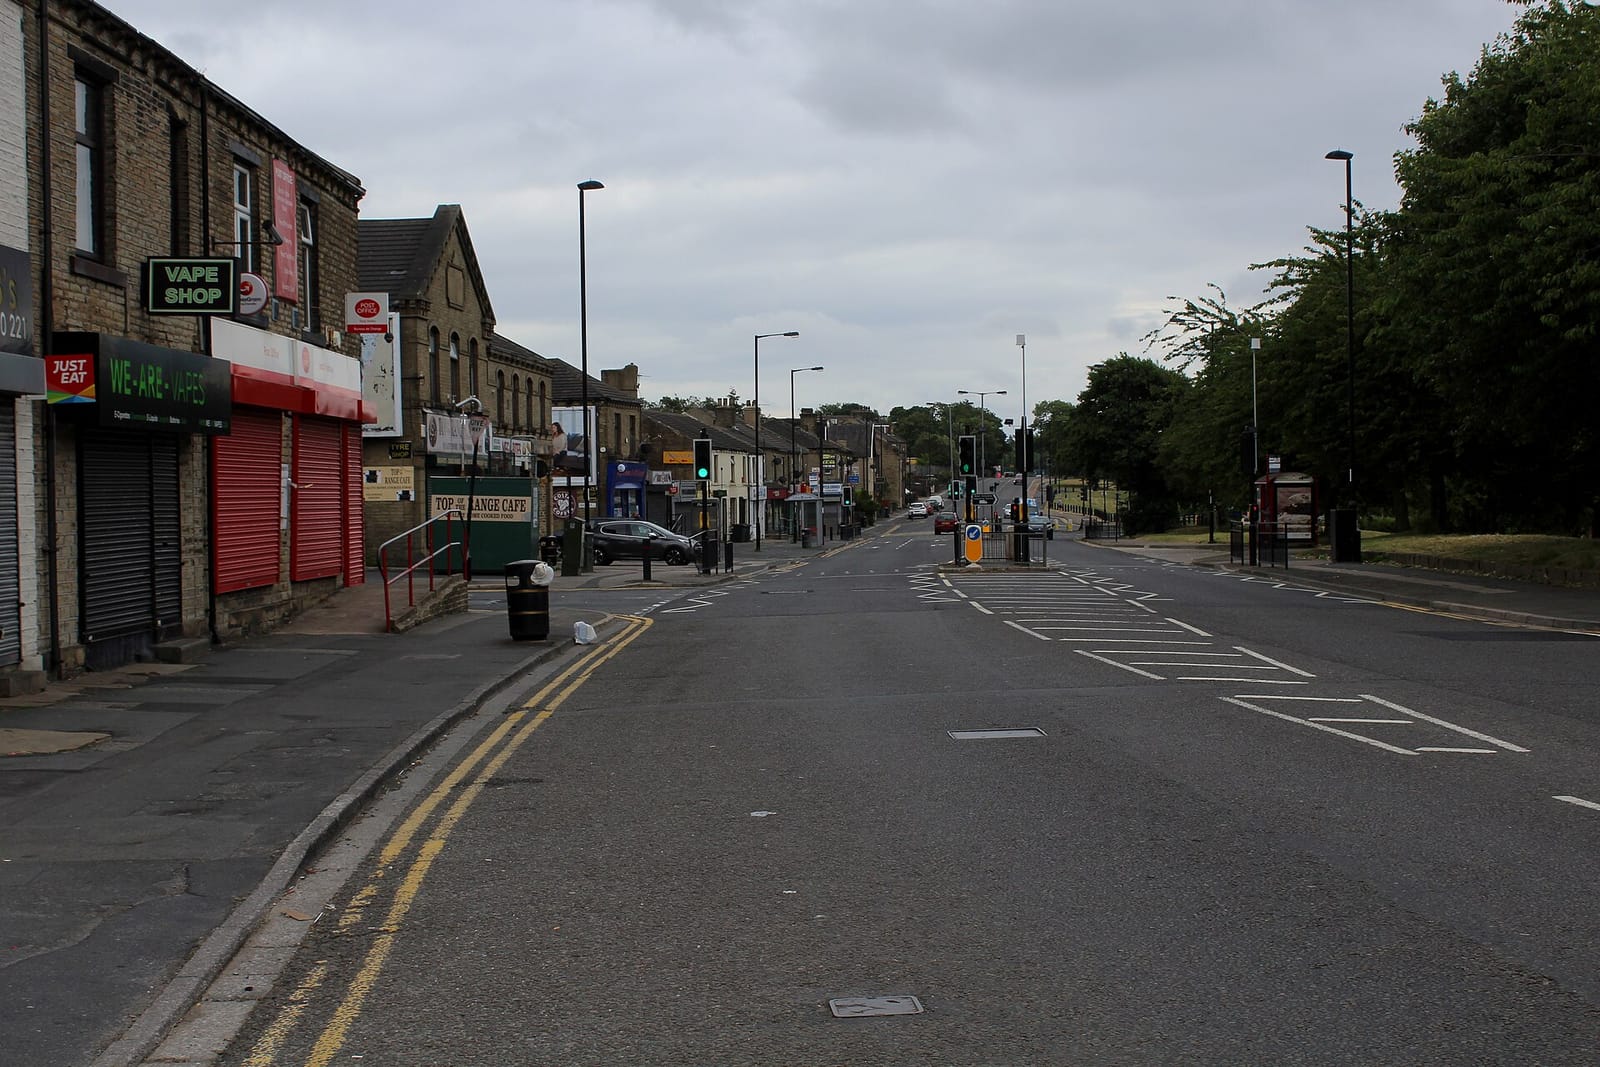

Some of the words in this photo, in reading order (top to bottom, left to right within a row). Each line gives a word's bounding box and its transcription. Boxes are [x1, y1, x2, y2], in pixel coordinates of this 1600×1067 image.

[164, 266, 219, 283] VAPE
[164, 287, 222, 304] SHOP
[9, 313, 27, 340] 221
[52, 359, 87, 374] JUST
[60, 371, 88, 384] EAT
[391, 443, 410, 451] TYRE
[385, 476, 399, 485] RANGE
[400, 476, 411, 485] CAFE
[436, 497, 454, 510] TOP
[502, 499, 527, 512] CAFE
